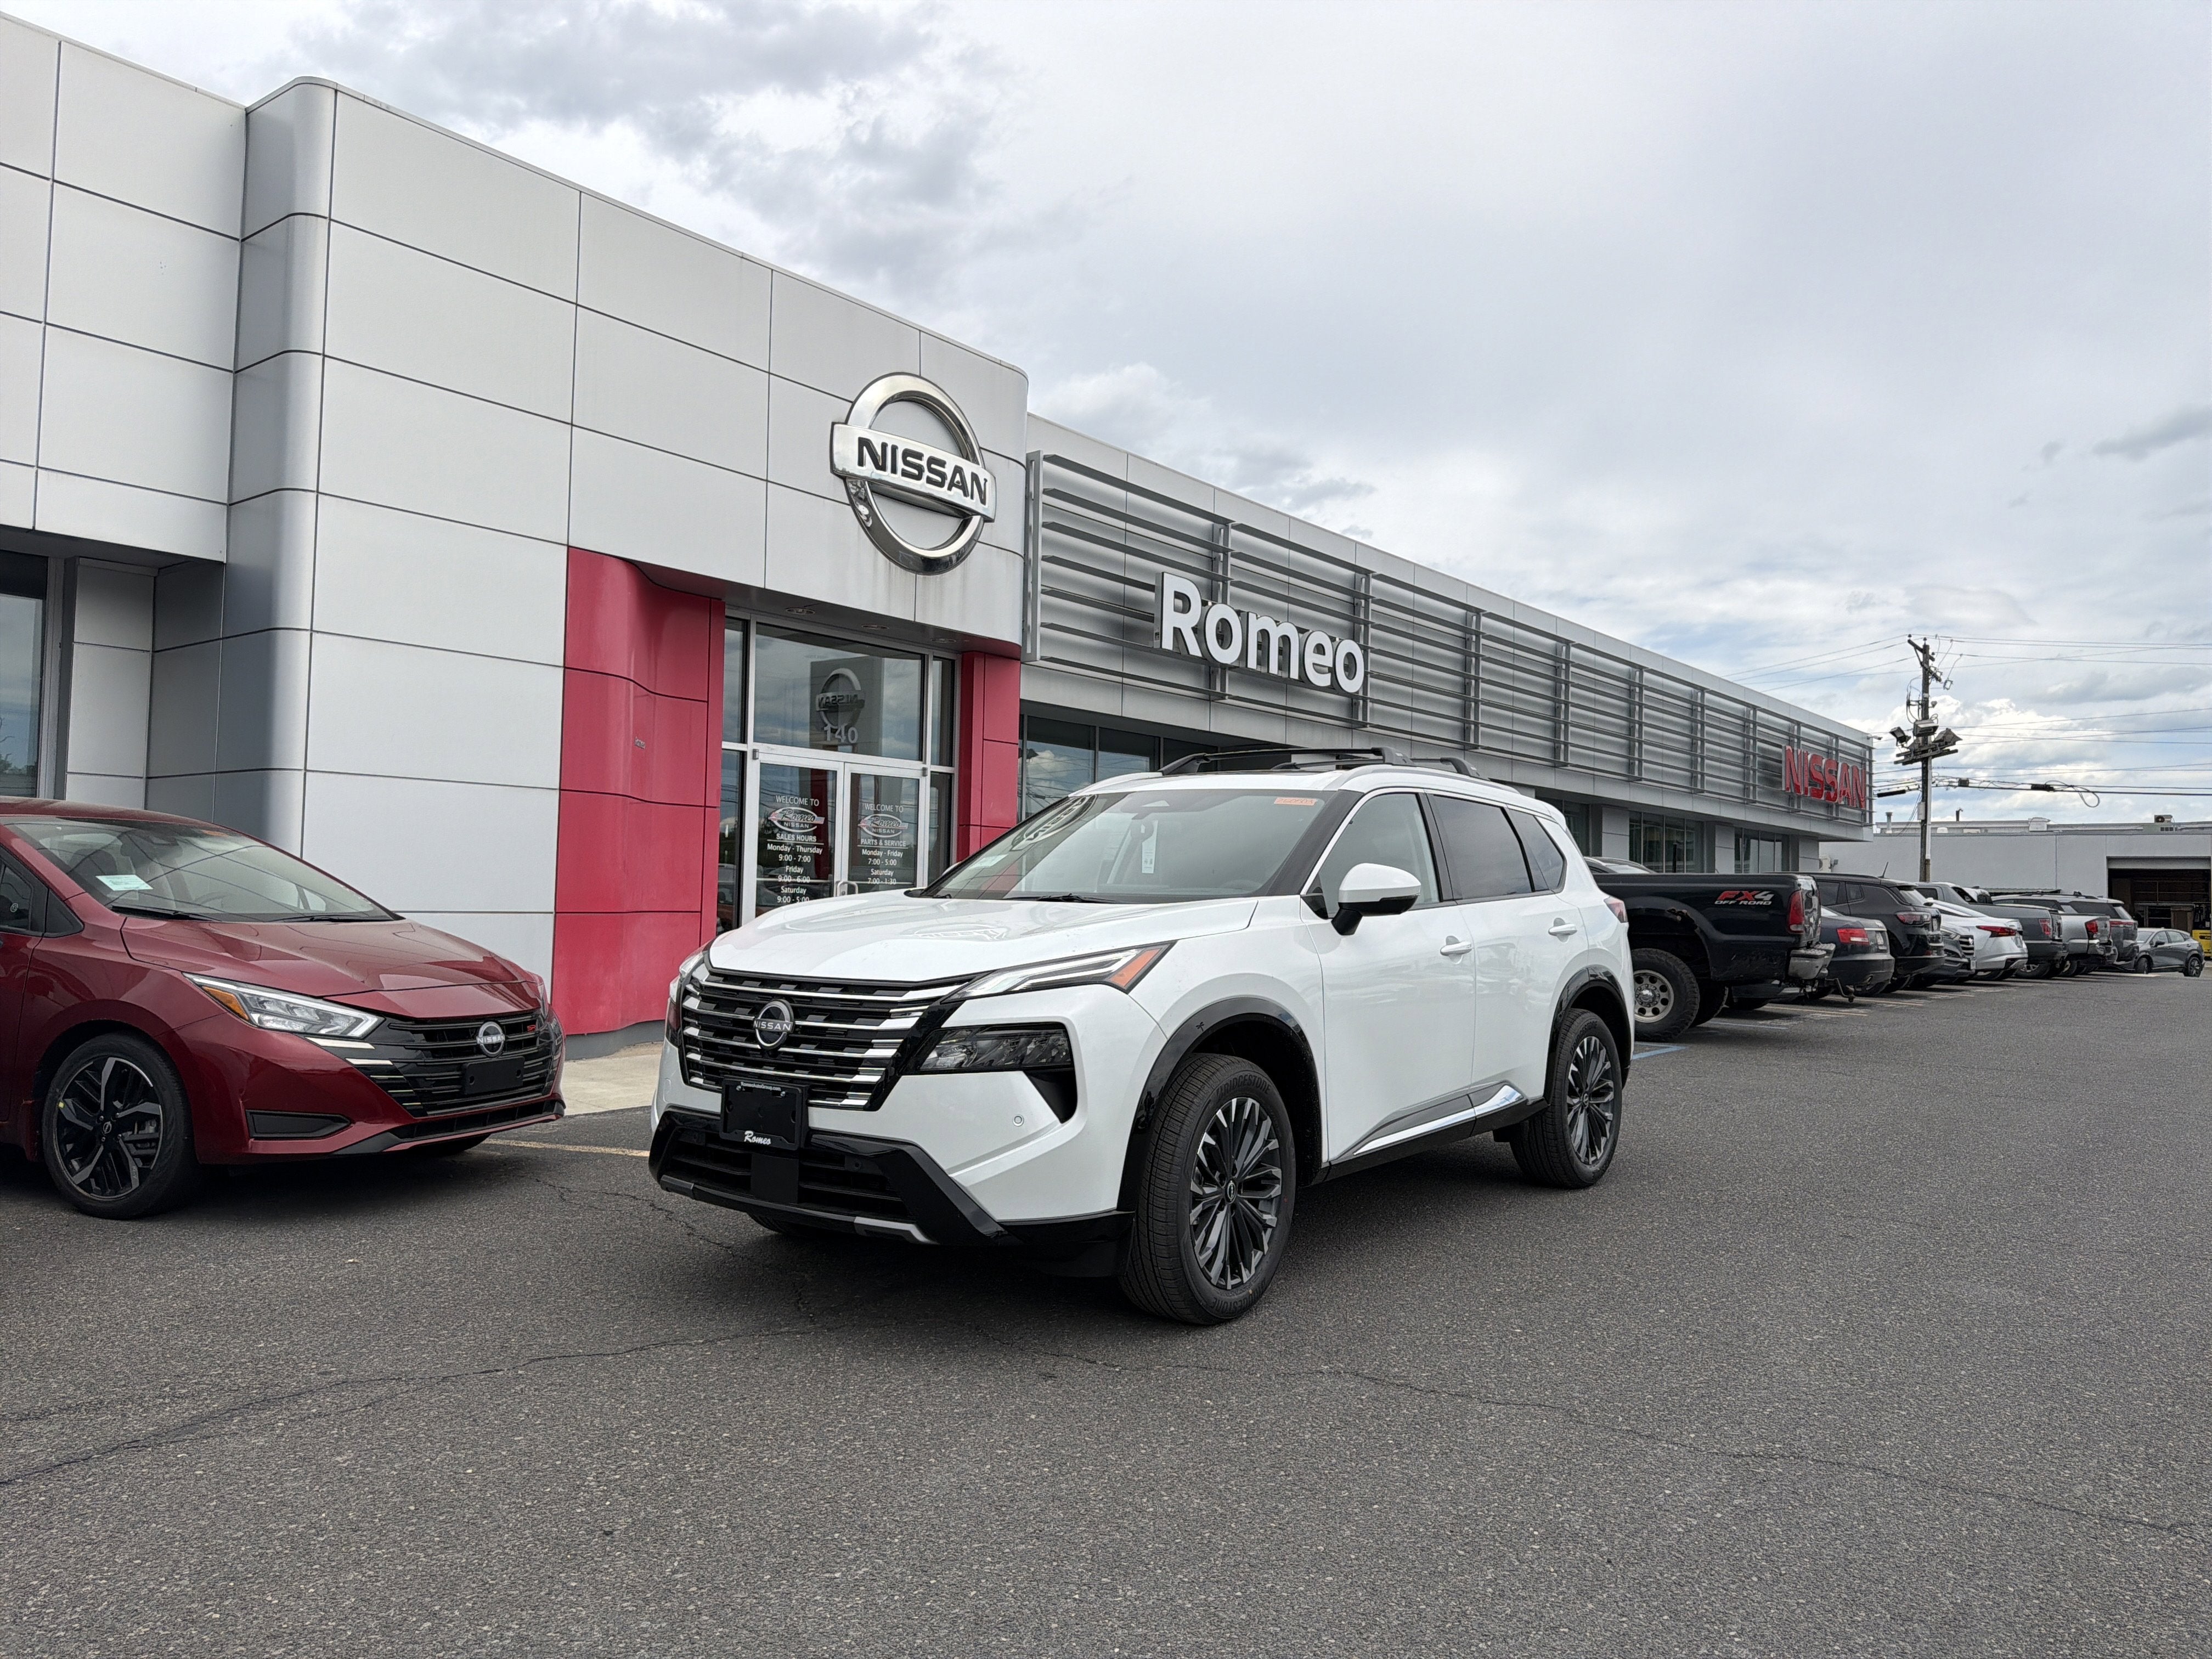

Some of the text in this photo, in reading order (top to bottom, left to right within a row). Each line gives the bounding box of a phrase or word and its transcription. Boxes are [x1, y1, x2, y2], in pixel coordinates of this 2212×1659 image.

[857, 436, 988, 506] NISSAN
[1160, 572, 1365, 693] Romeo
[824, 723, 858, 743] 140
[1783, 745, 1867, 809] NISSAN
[776, 795, 808, 805] WELCOME
[864, 803, 904, 813] WELCOME TO
[781, 809, 816, 822] Romeo
[870, 816, 901, 828] Romeo
[767, 843, 791, 853] Monday
[796, 845, 823, 855] Thursday
[862, 849, 883, 857] Monday
[786, 866, 804, 874] Friday
[871, 868, 894, 877] Saturday
[781, 886, 806, 895] Saturday
[1717, 890, 1775, 901] FX4
[753, 1020, 791, 1031] NISSAN
[477, 1035, 505, 1045] NISSAN
[1216, 1074, 1271, 1099] BRIDGESTONE
[744, 1130, 771, 1145] Romeo
